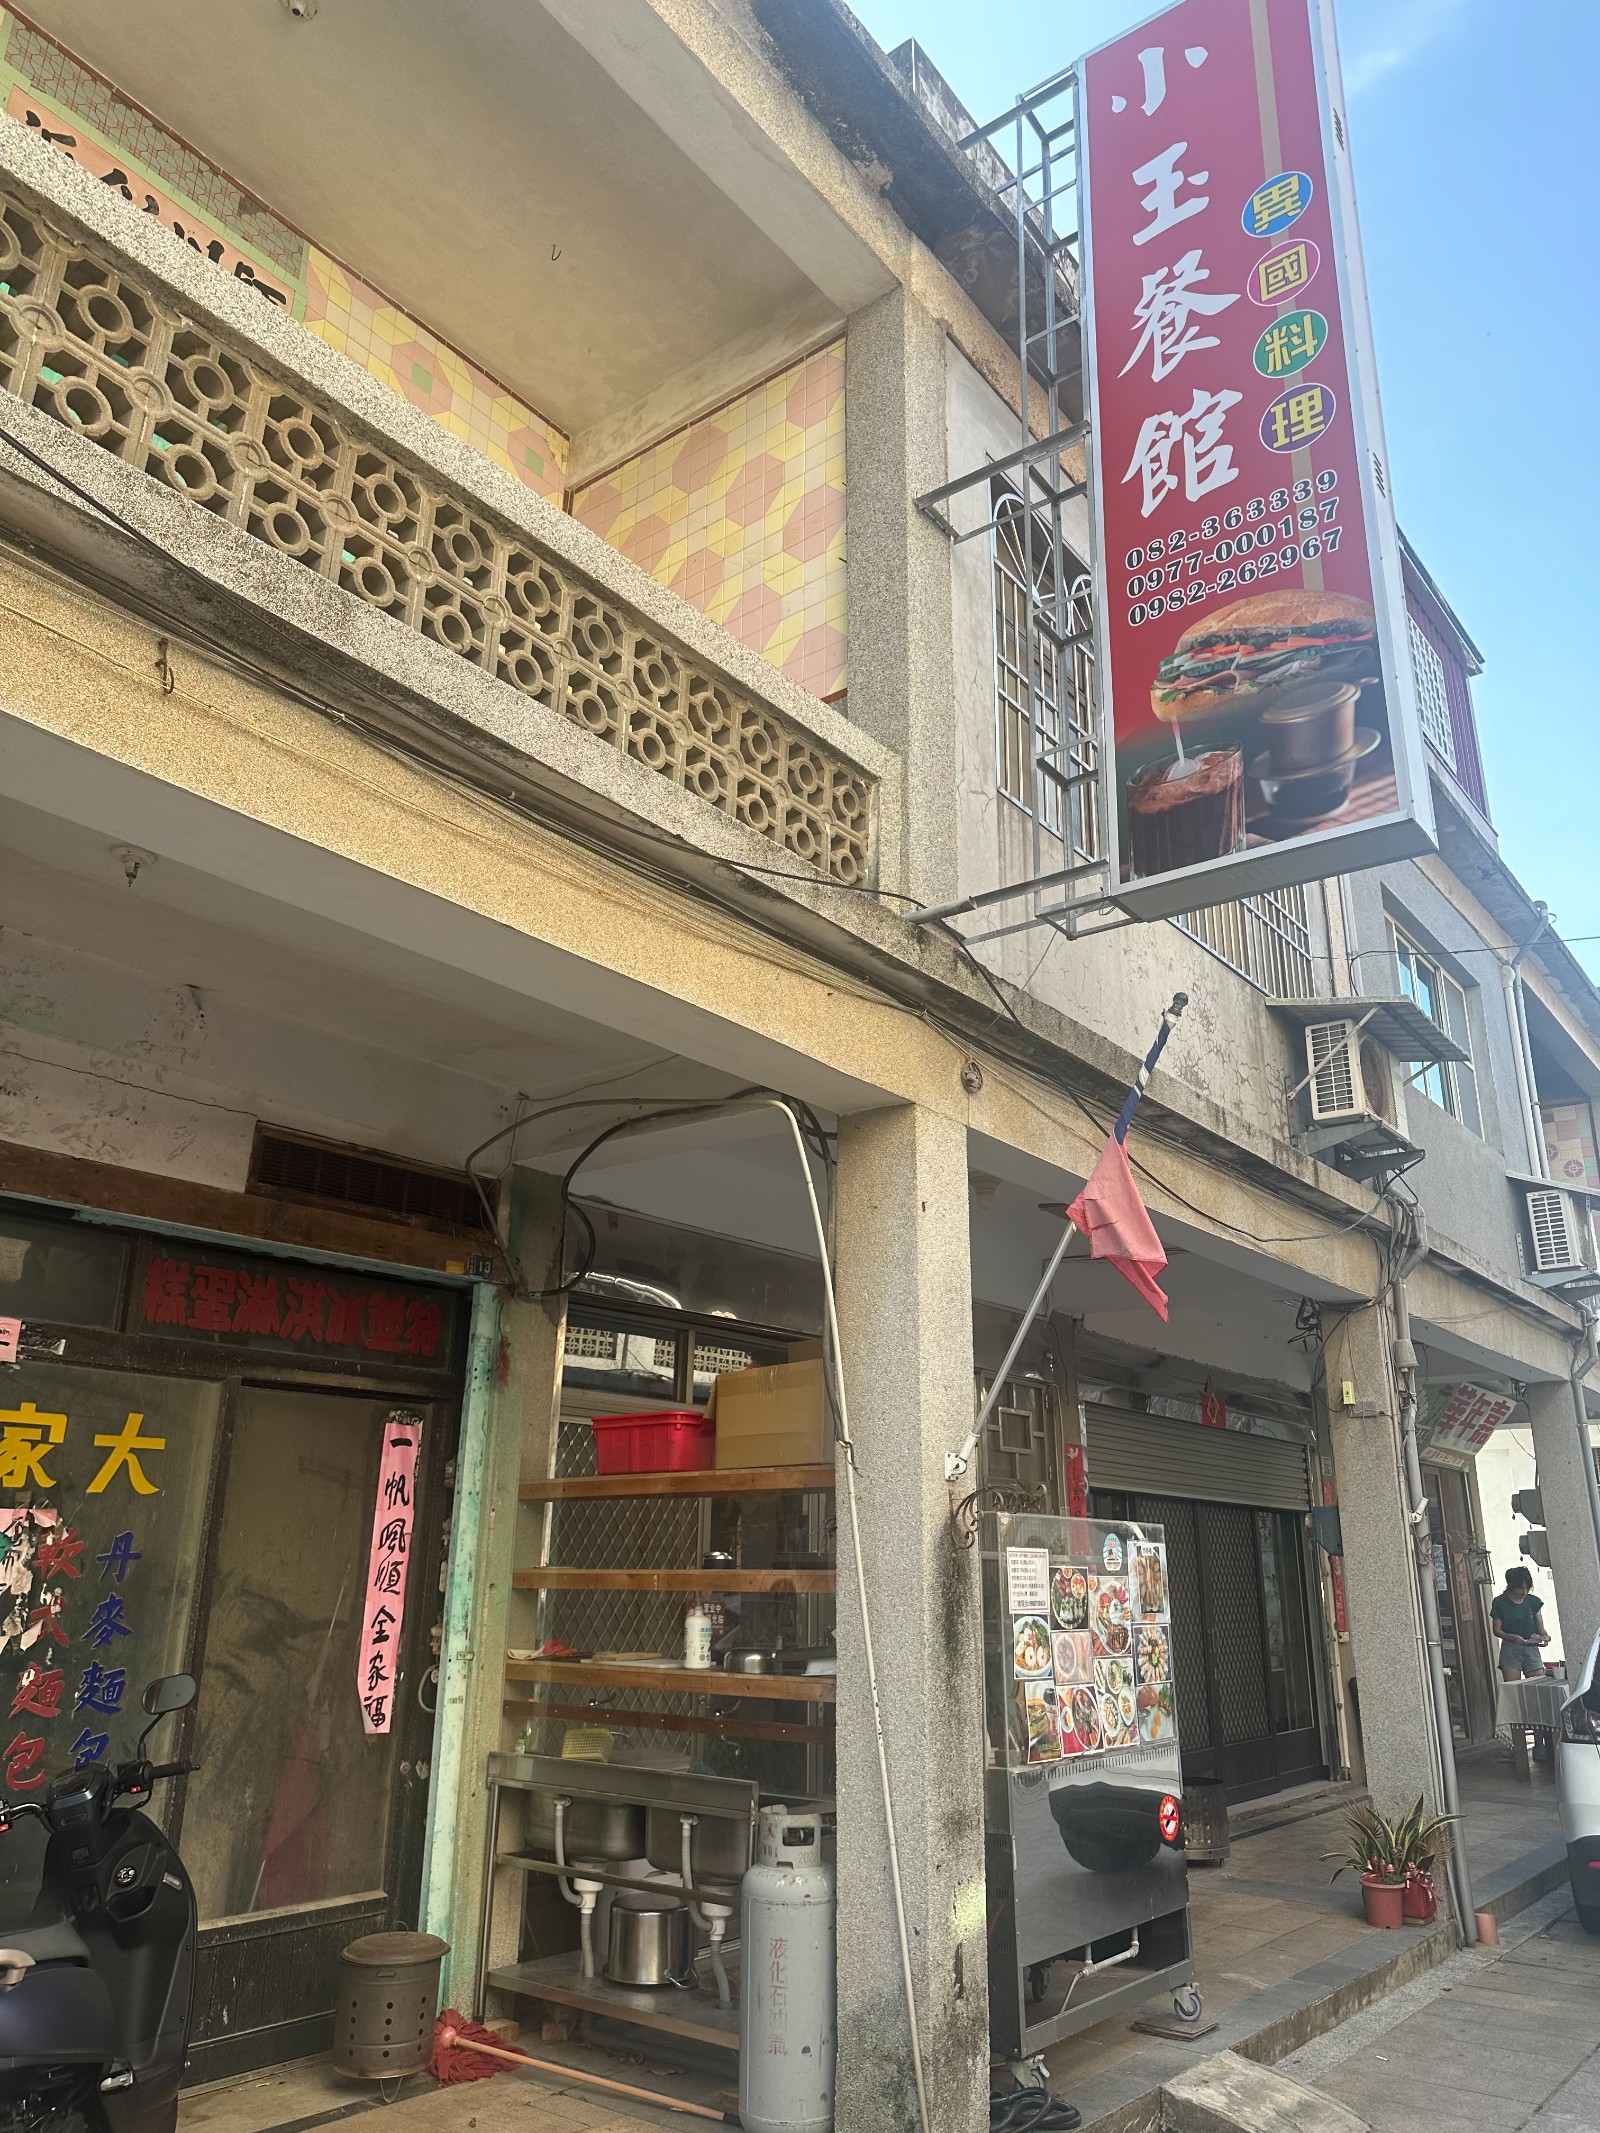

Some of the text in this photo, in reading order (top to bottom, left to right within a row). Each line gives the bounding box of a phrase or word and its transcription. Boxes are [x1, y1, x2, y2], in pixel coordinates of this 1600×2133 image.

[1111, 46, 1243, 518] 小玉餐館
[1252, 174, 1326, 450] 異國料理
[1125, 469, 1338, 570] 082-363339
[1126, 497, 1340, 598] 0977-000187
[1128, 527, 1343, 627] 0982-262967
[479, 1261, 491, 1273] 13
